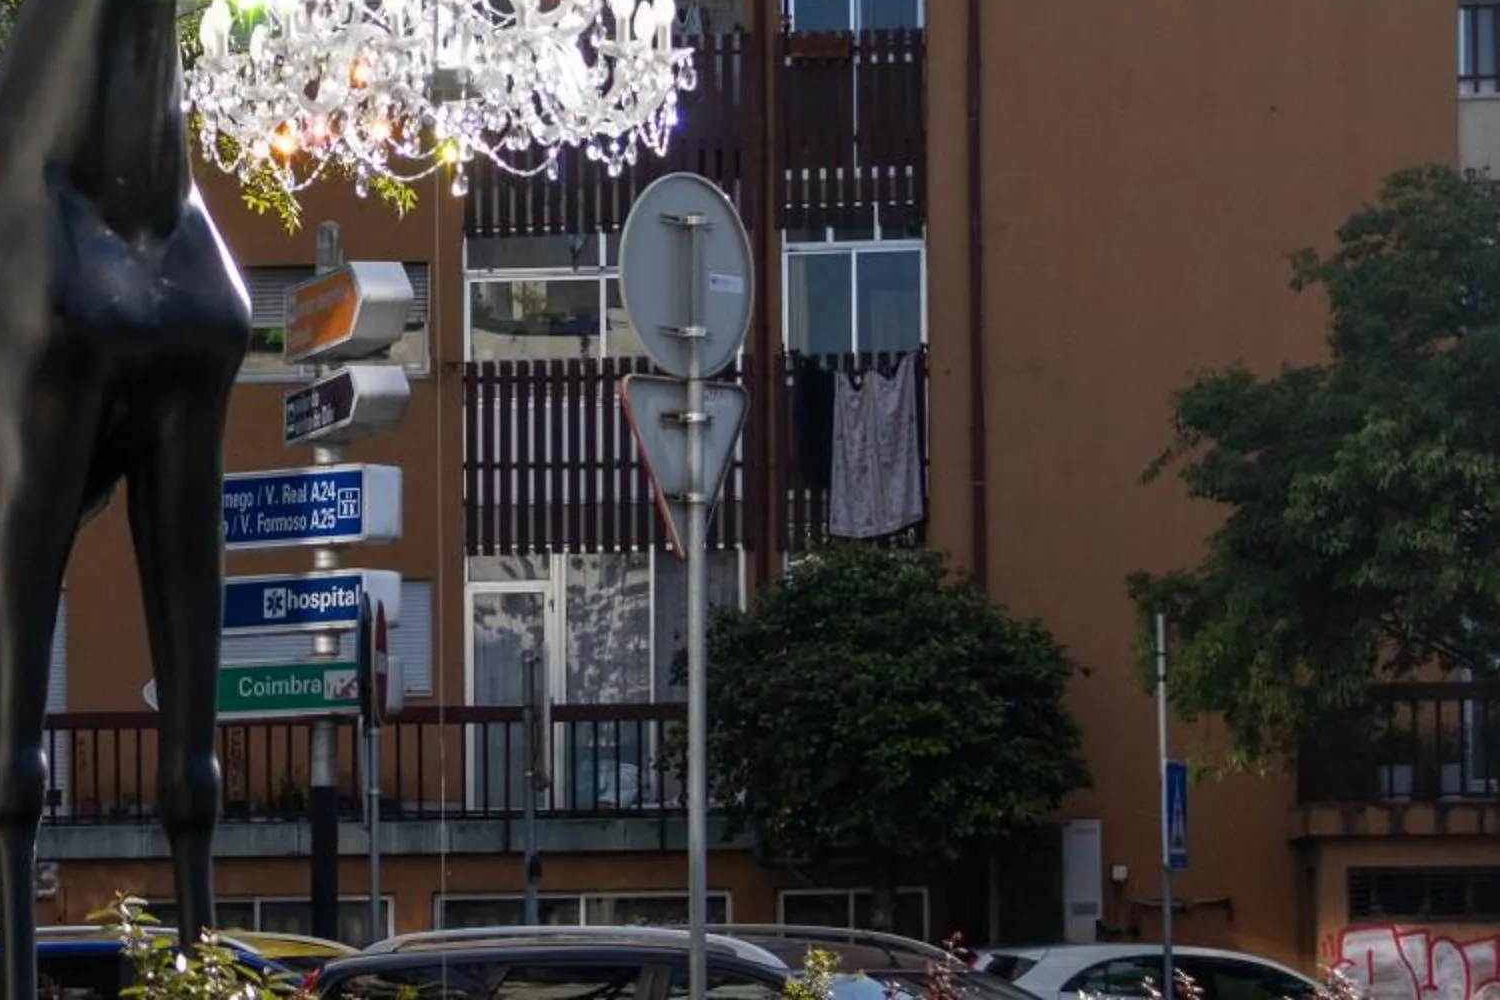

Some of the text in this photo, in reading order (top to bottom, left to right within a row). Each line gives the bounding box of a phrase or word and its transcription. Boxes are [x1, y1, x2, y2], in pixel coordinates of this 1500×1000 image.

[282, 482, 308, 504] Real
[310, 480, 337, 502] A24
[257, 511, 307, 534] Formoso
[310, 507, 337, 530] A25
[287, 584, 360, 613] hospital
[238, 674, 322, 698] Coimbra
